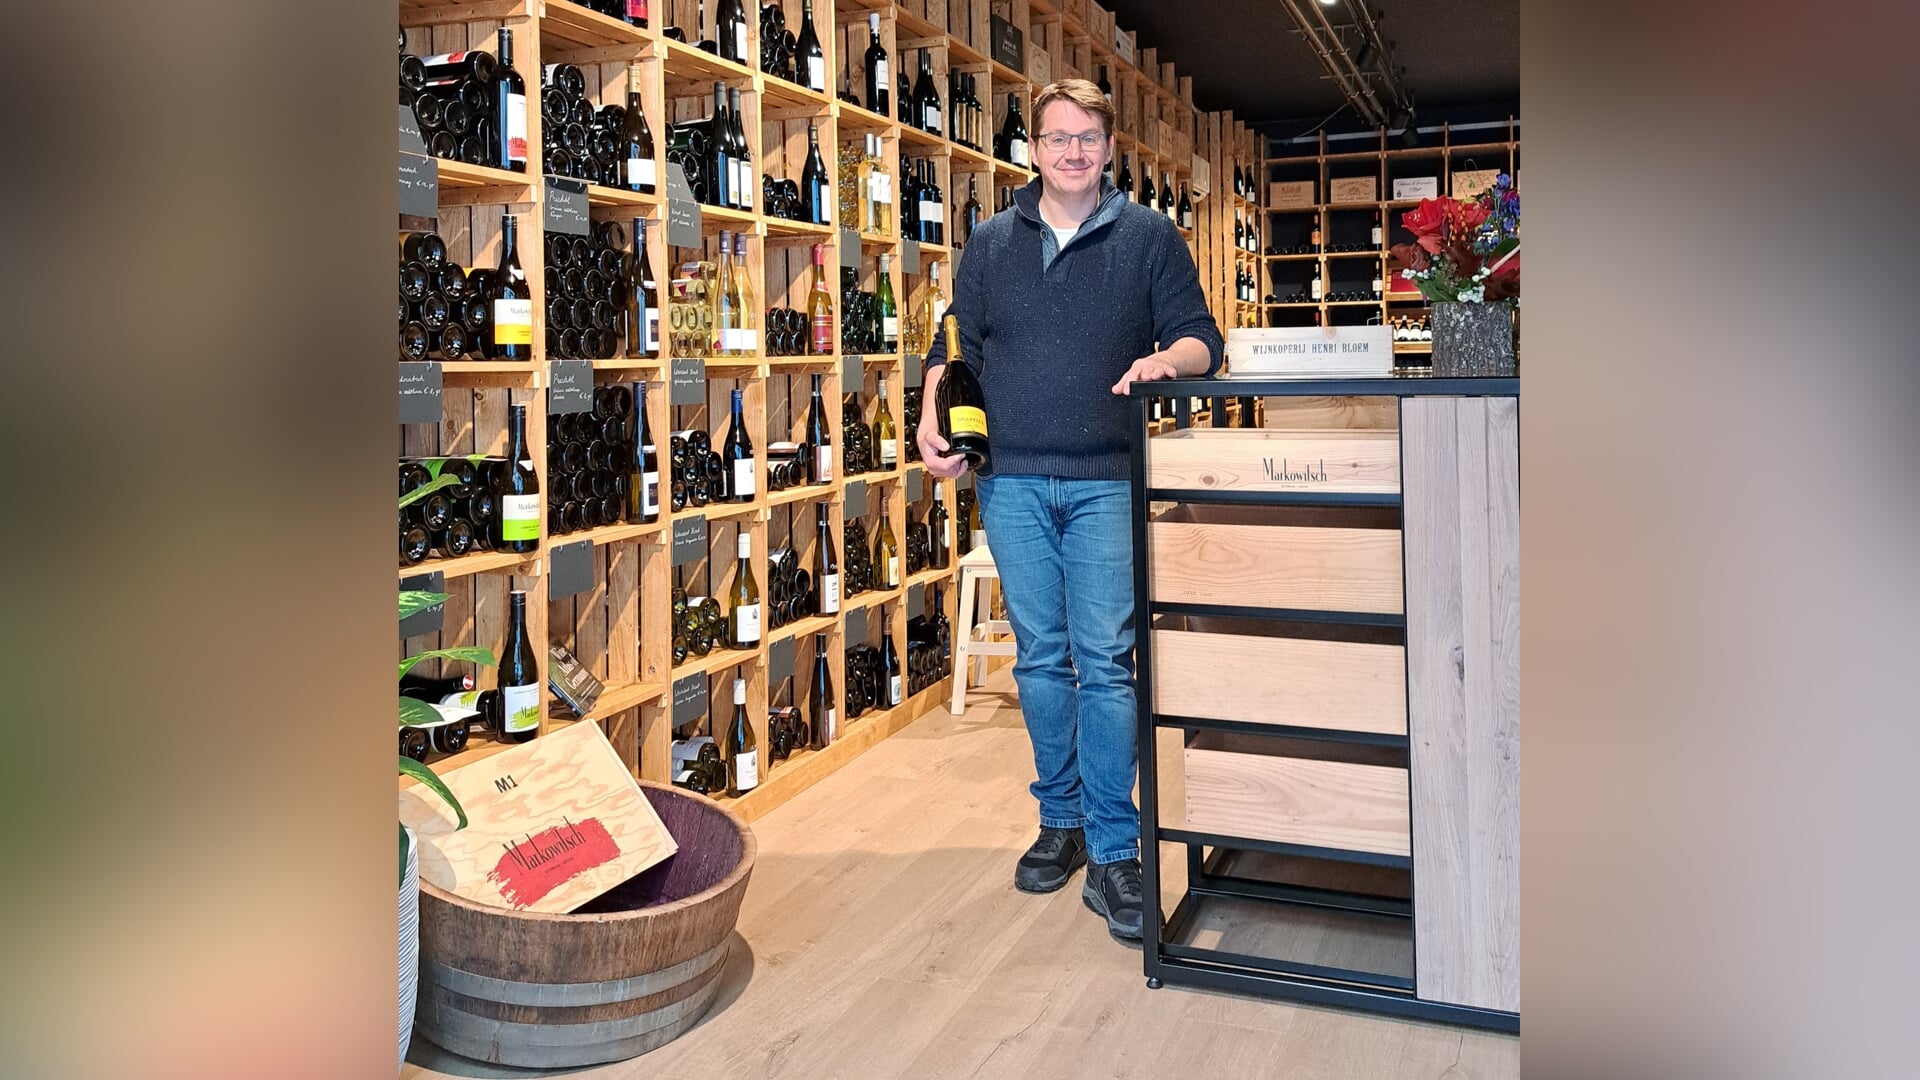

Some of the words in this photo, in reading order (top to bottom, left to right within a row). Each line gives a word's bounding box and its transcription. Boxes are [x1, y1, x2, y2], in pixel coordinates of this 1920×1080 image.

[1252, 343, 1306, 355] WIJNKOPERIJ
[1311, 343, 1337, 354] HENRI
[1342, 342, 1369, 353] BLOEM
[1262, 457, 1327, 482] Markowitsch
[565, 667, 592, 690] Germany
[494, 774, 519, 794] M1
[502, 815, 587, 876] Markowitsch
